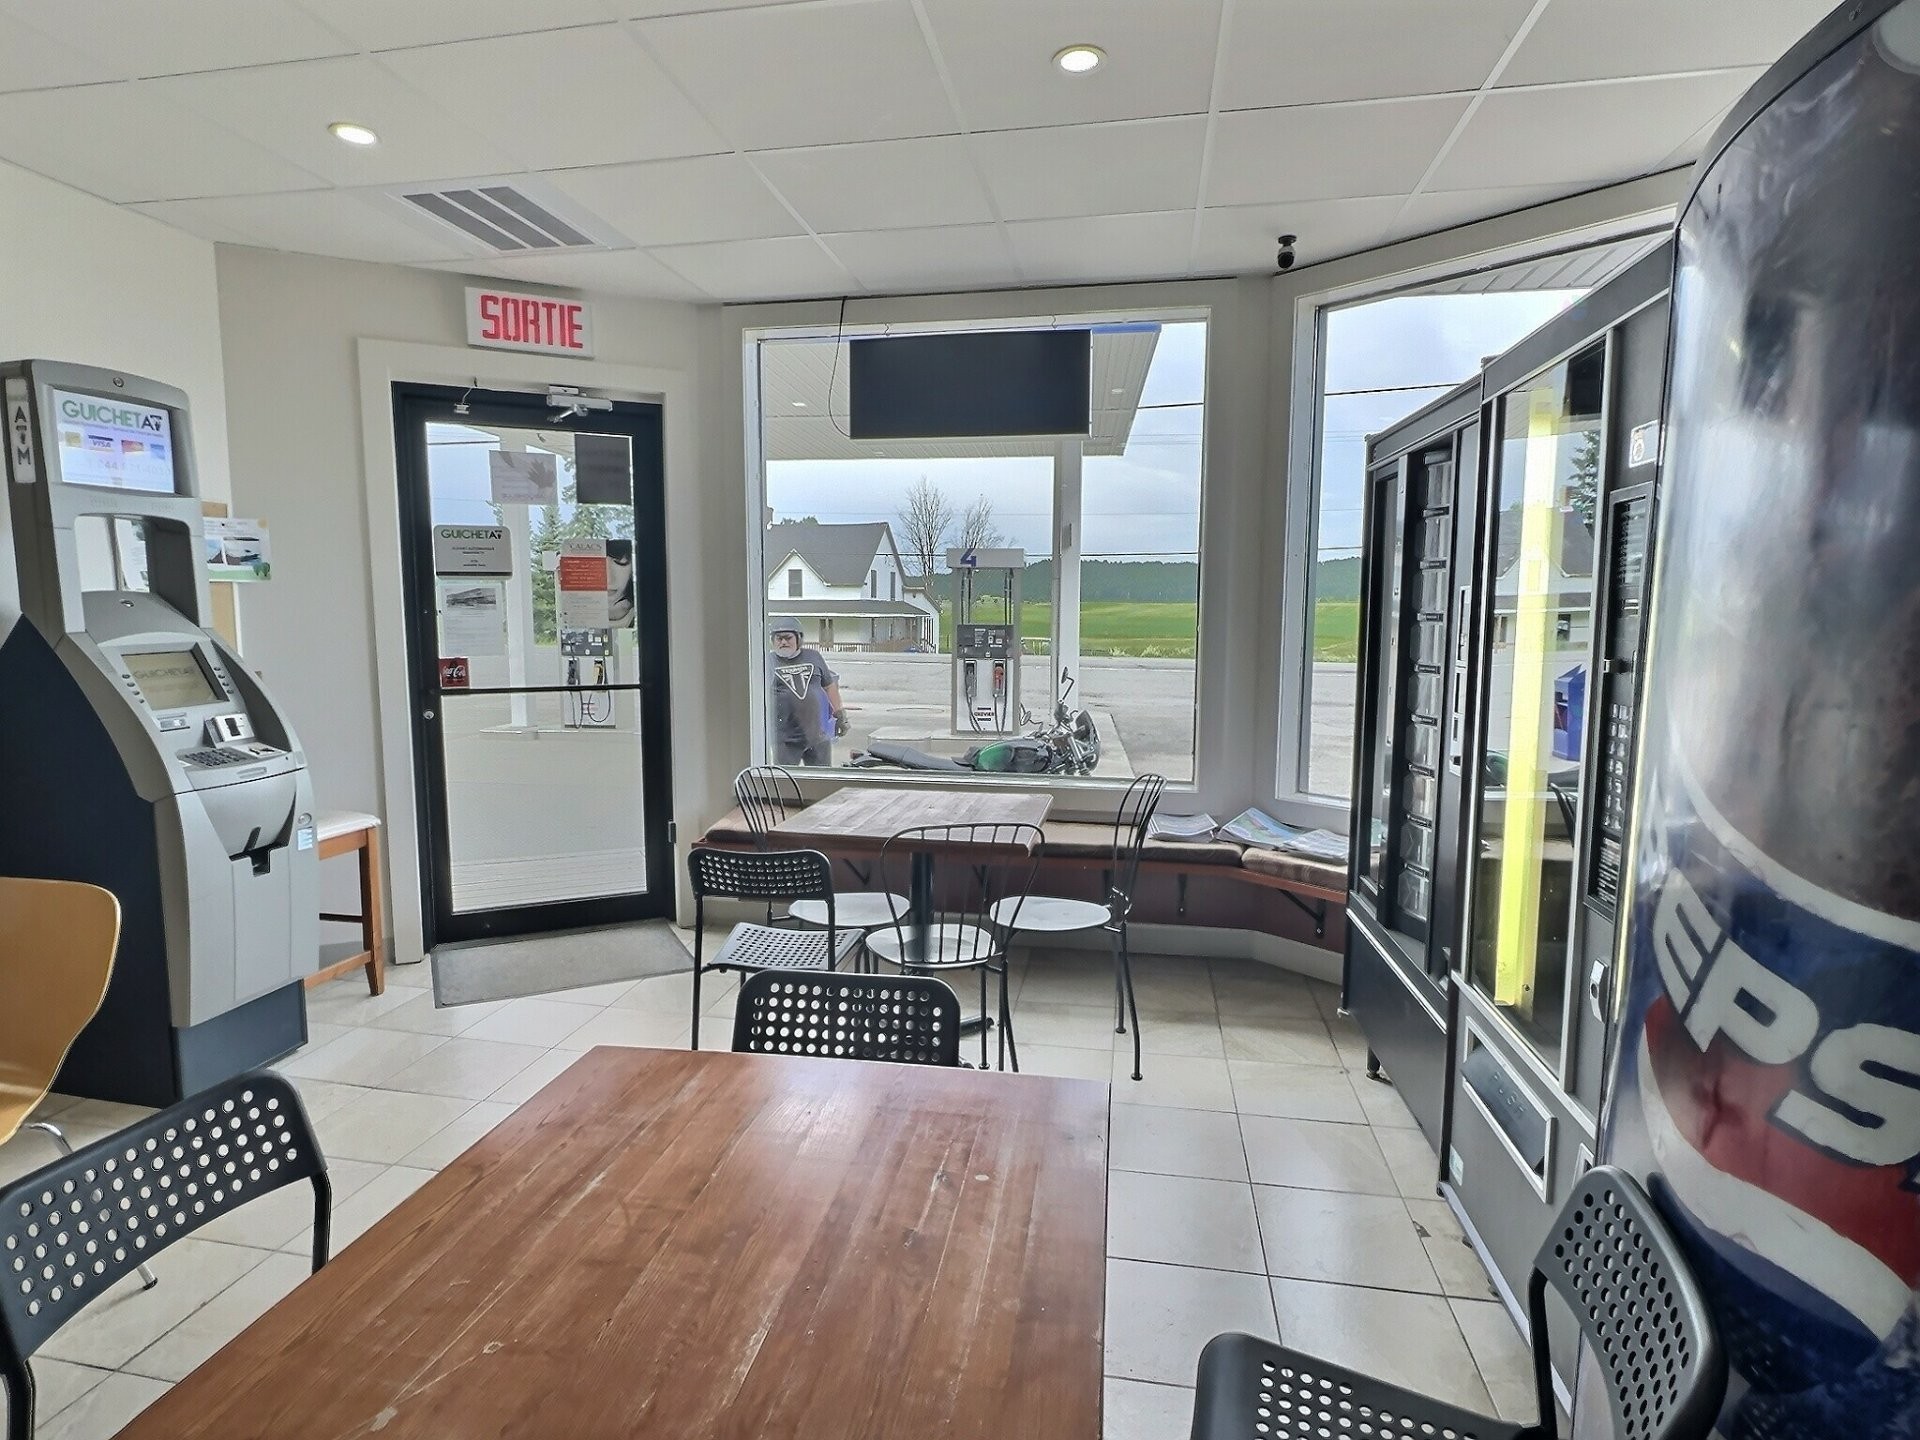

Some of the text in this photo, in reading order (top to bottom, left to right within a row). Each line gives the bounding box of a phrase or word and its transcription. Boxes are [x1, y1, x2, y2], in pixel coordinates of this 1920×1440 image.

[480, 294, 584, 349] SORTIE
[92, 440, 111, 448] VISA
[960, 548, 977, 568] 4
